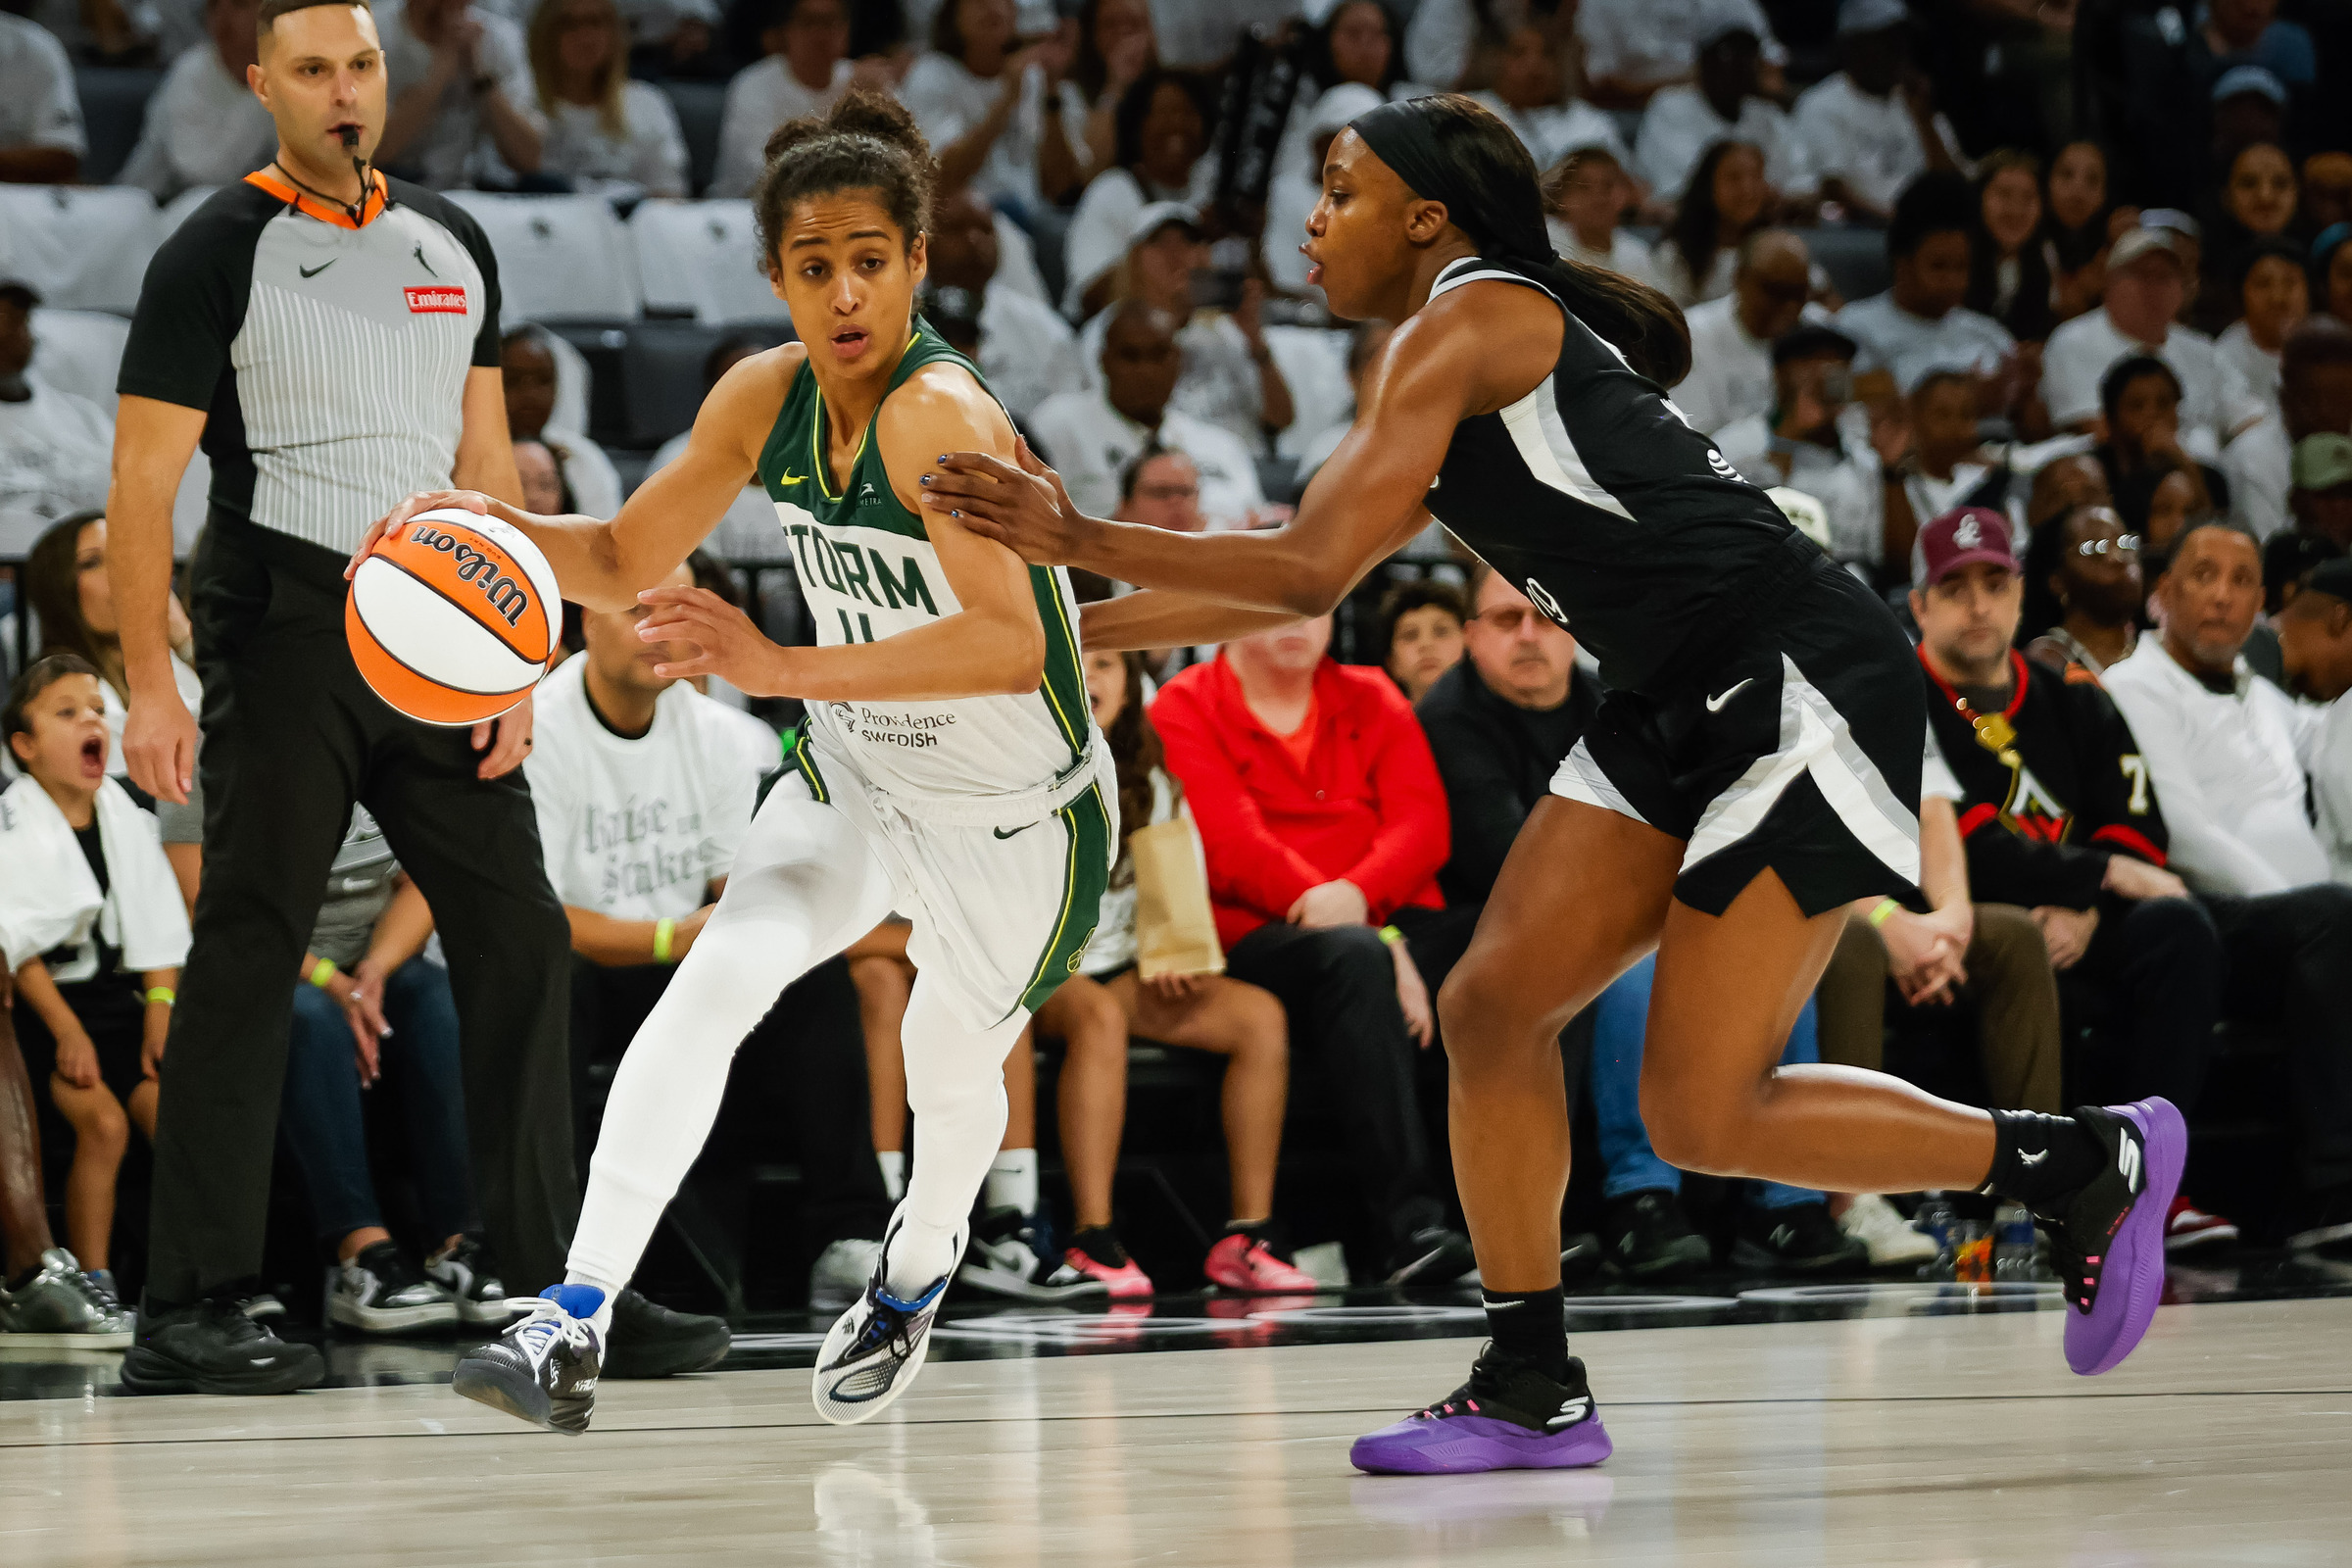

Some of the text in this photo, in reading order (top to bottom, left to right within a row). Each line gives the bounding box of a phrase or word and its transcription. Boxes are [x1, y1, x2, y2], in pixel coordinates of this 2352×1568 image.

[407, 291, 466, 307] Emirates
[410, 525, 529, 629] Wilson
[782, 523, 940, 617] TORM
[860, 707, 957, 729] Providence
[861, 729, 938, 748] SWEDISH
[2119, 753, 2149, 816] 7
